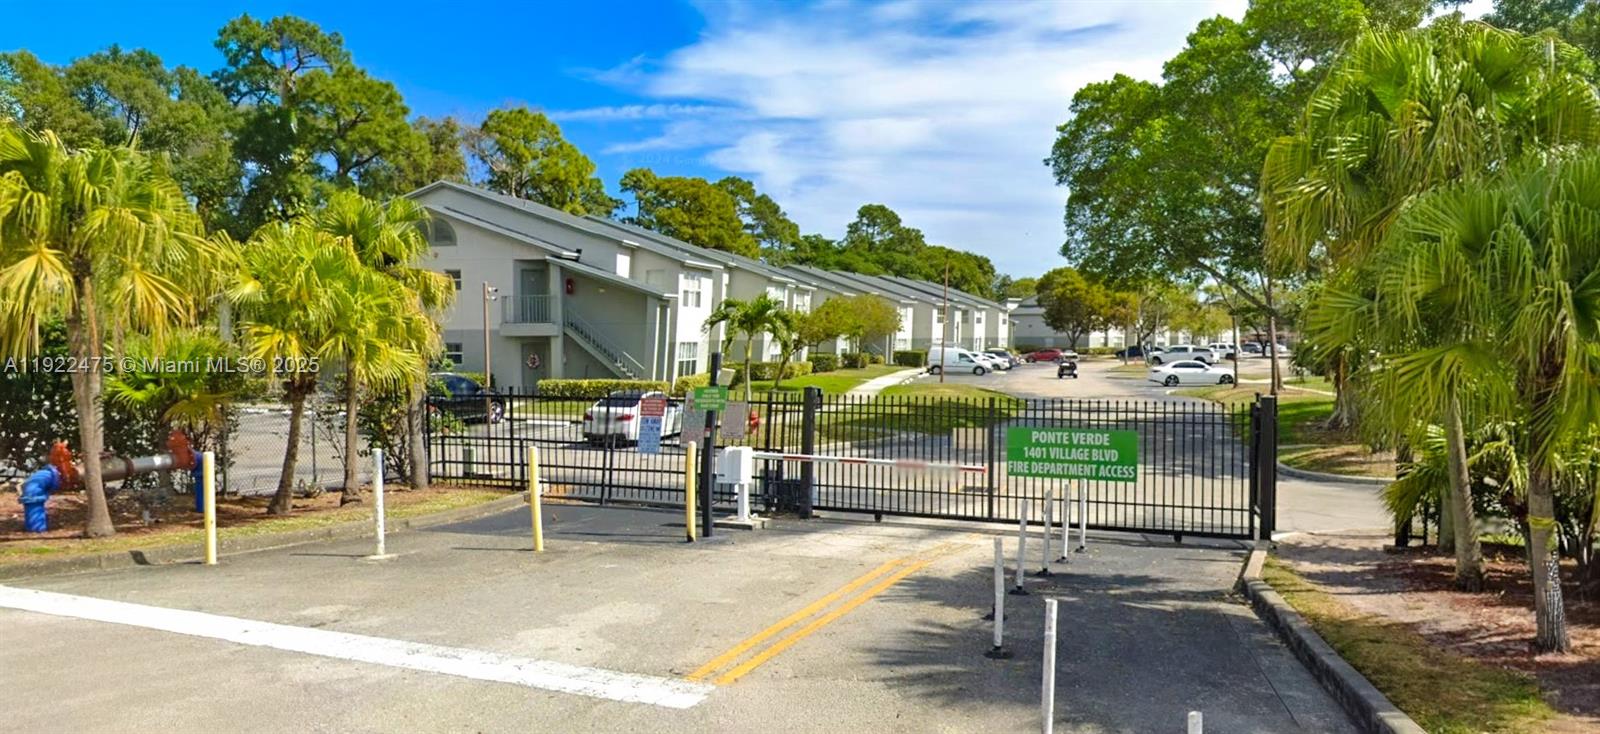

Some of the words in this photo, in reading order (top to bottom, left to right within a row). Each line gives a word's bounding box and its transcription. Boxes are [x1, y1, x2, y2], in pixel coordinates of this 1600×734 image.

[1031, 431, 1069, 444] PONTE
[1072, 432, 1110, 446] VERDE
[1024, 446, 1046, 459] 1401
[1050, 447, 1089, 461] VILLAGE
[1092, 449, 1119, 462] BLVD
[1008, 461, 1029, 473] FIRE
[1031, 462, 1096, 477] DEPARTMENT
[1099, 466, 1135, 478] ACCESS
